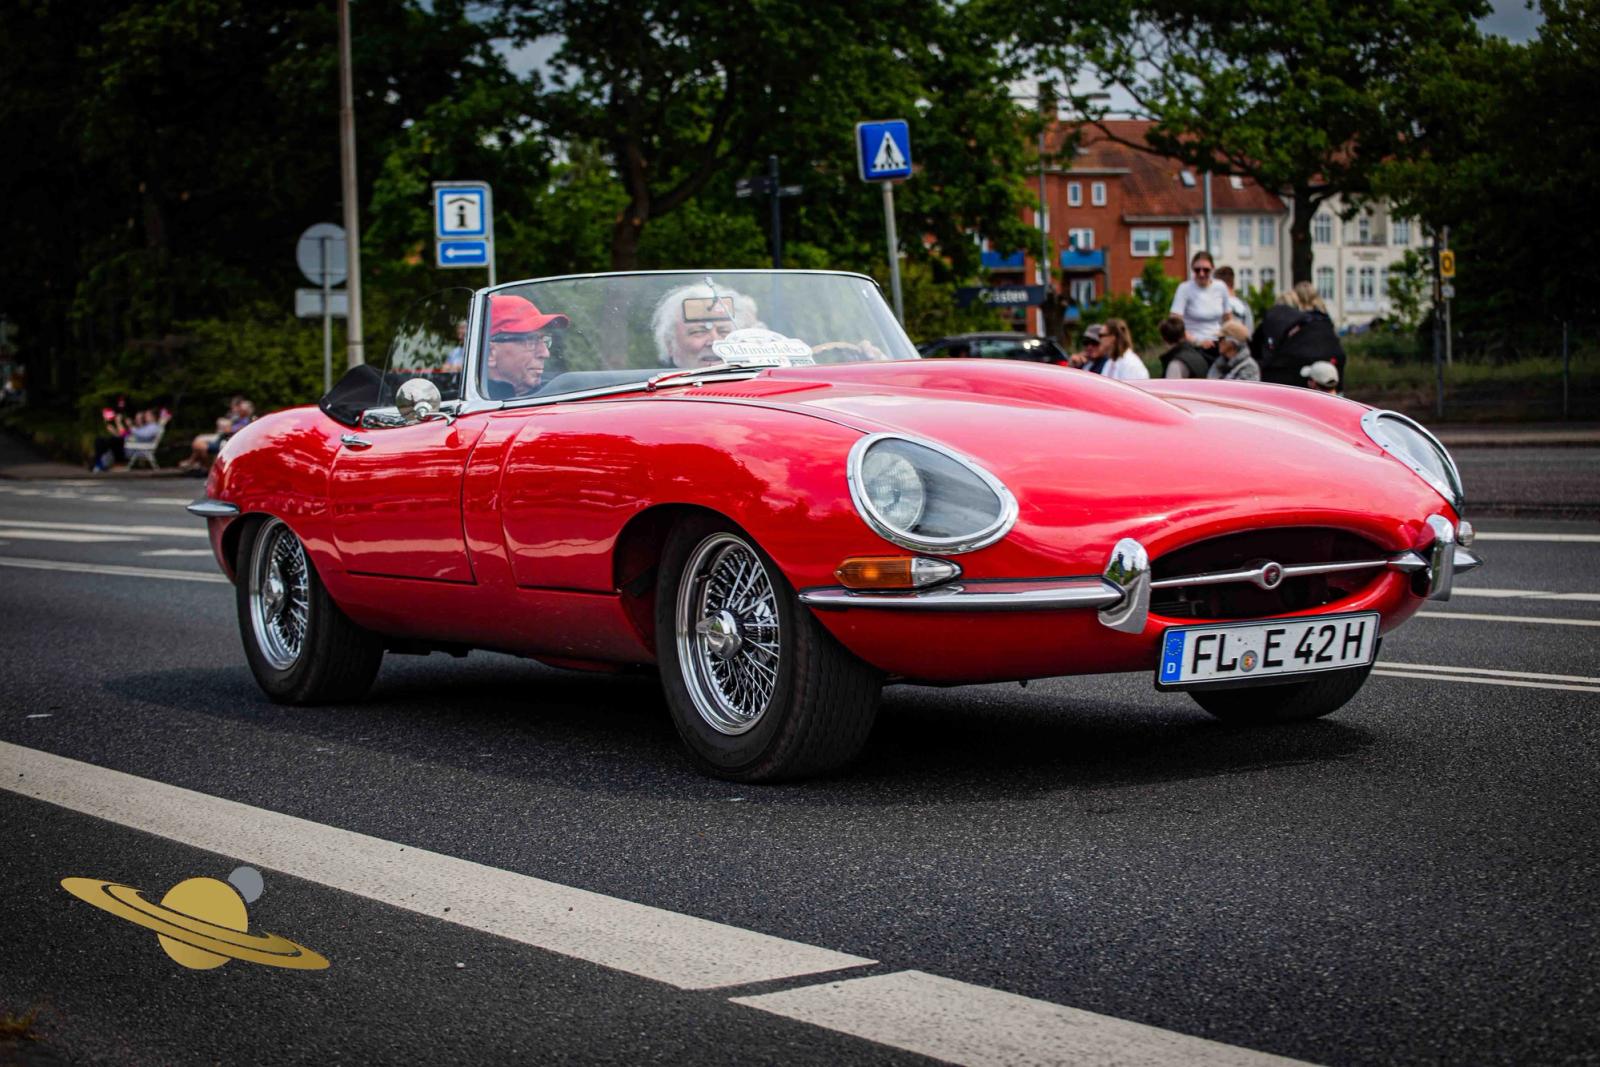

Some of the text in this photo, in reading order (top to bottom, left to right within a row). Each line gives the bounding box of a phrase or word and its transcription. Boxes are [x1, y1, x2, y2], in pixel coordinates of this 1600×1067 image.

[1191, 634, 1238, 674] FL
[1262, 629, 1286, 668] E
[1166, 662, 1176, 674] D
